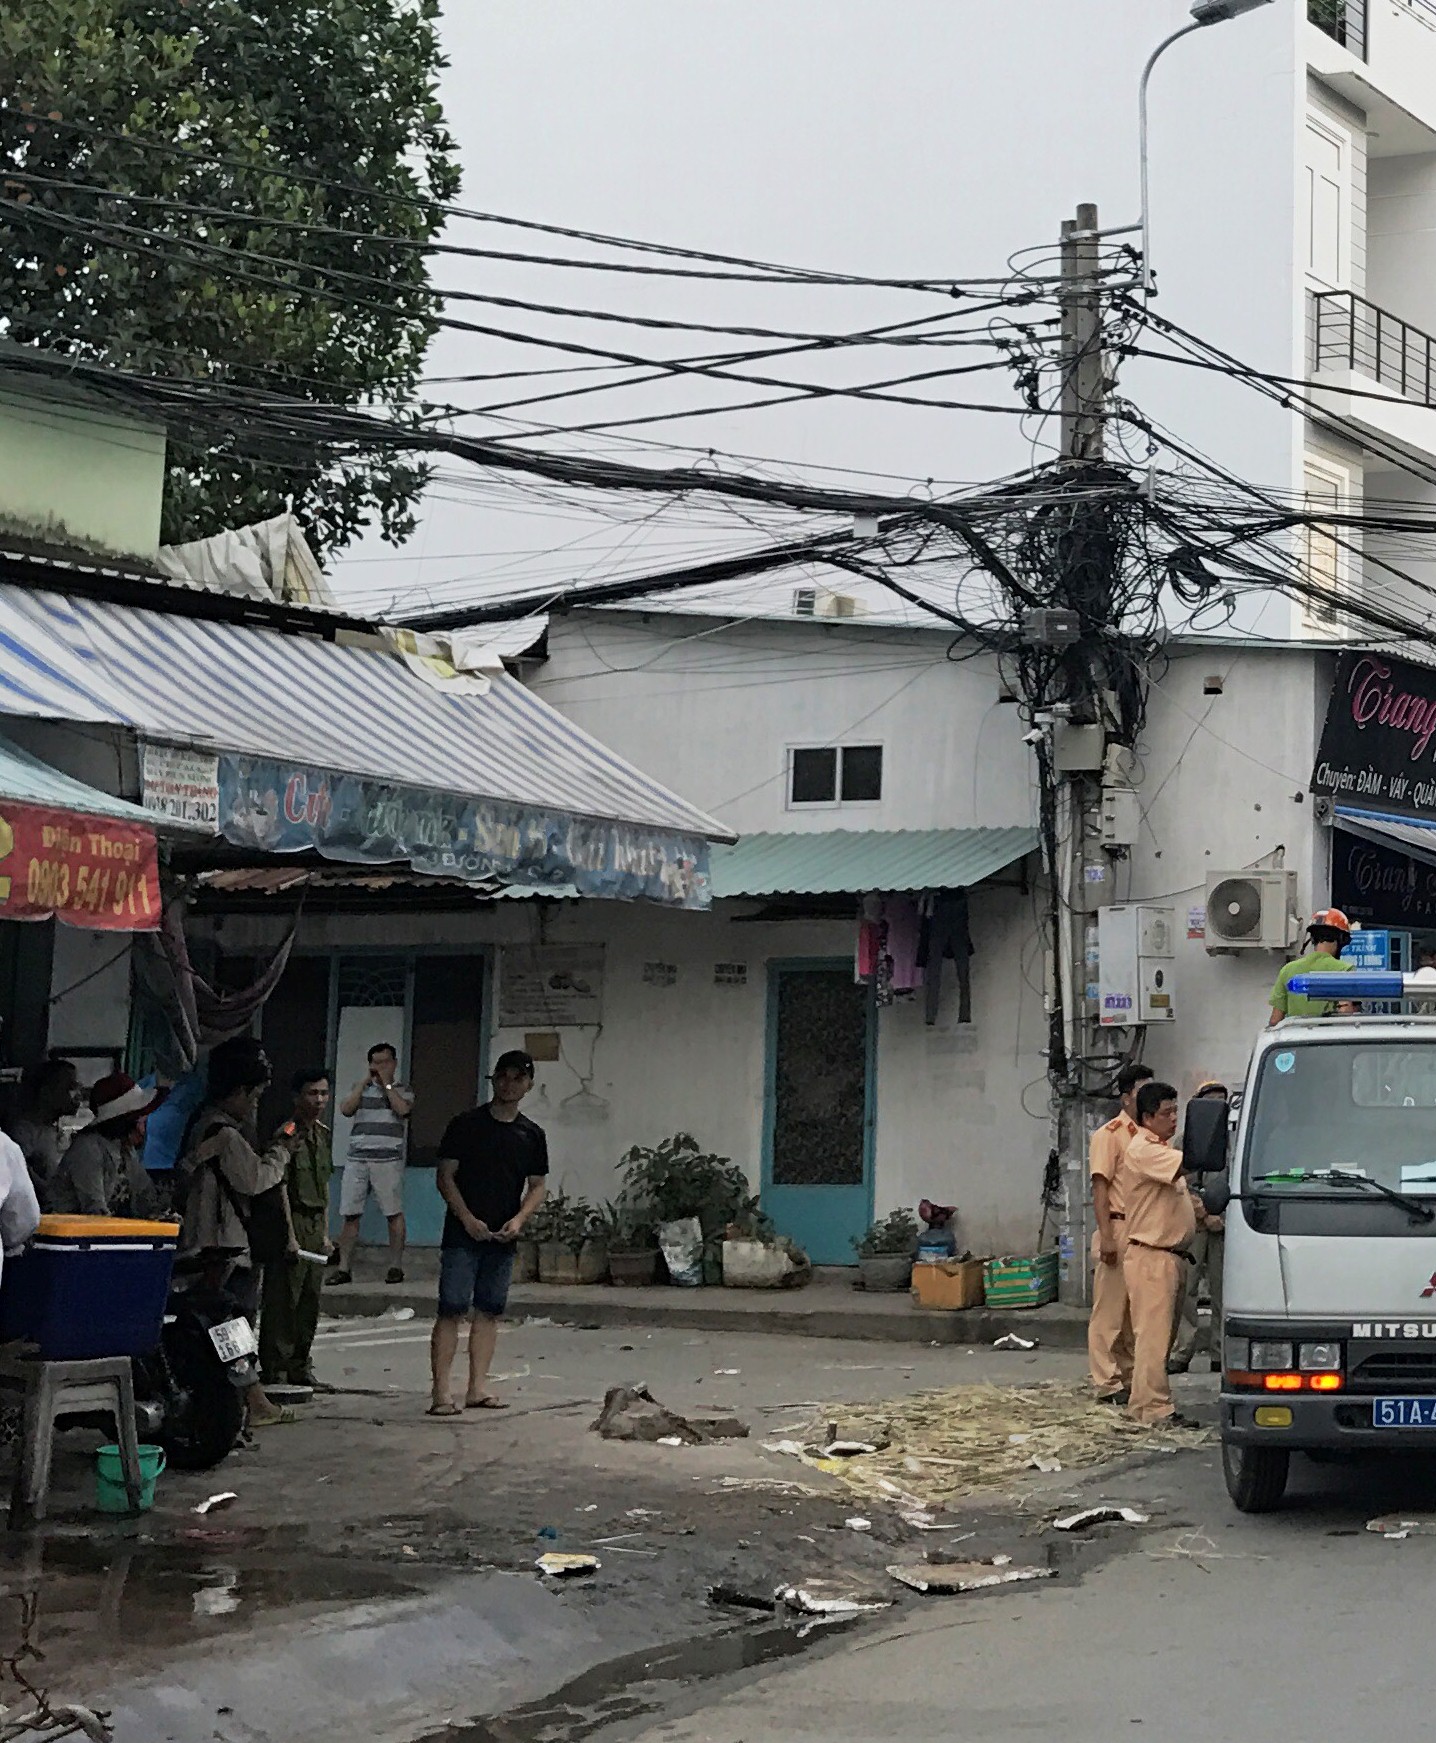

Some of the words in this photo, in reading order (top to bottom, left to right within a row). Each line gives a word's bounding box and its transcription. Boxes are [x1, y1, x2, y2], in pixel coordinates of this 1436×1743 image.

[1316, 762, 1357, 794] Chuyên:
[1388, 772, 1409, 800] VÁY
[88, 833, 140, 866] Thoại
